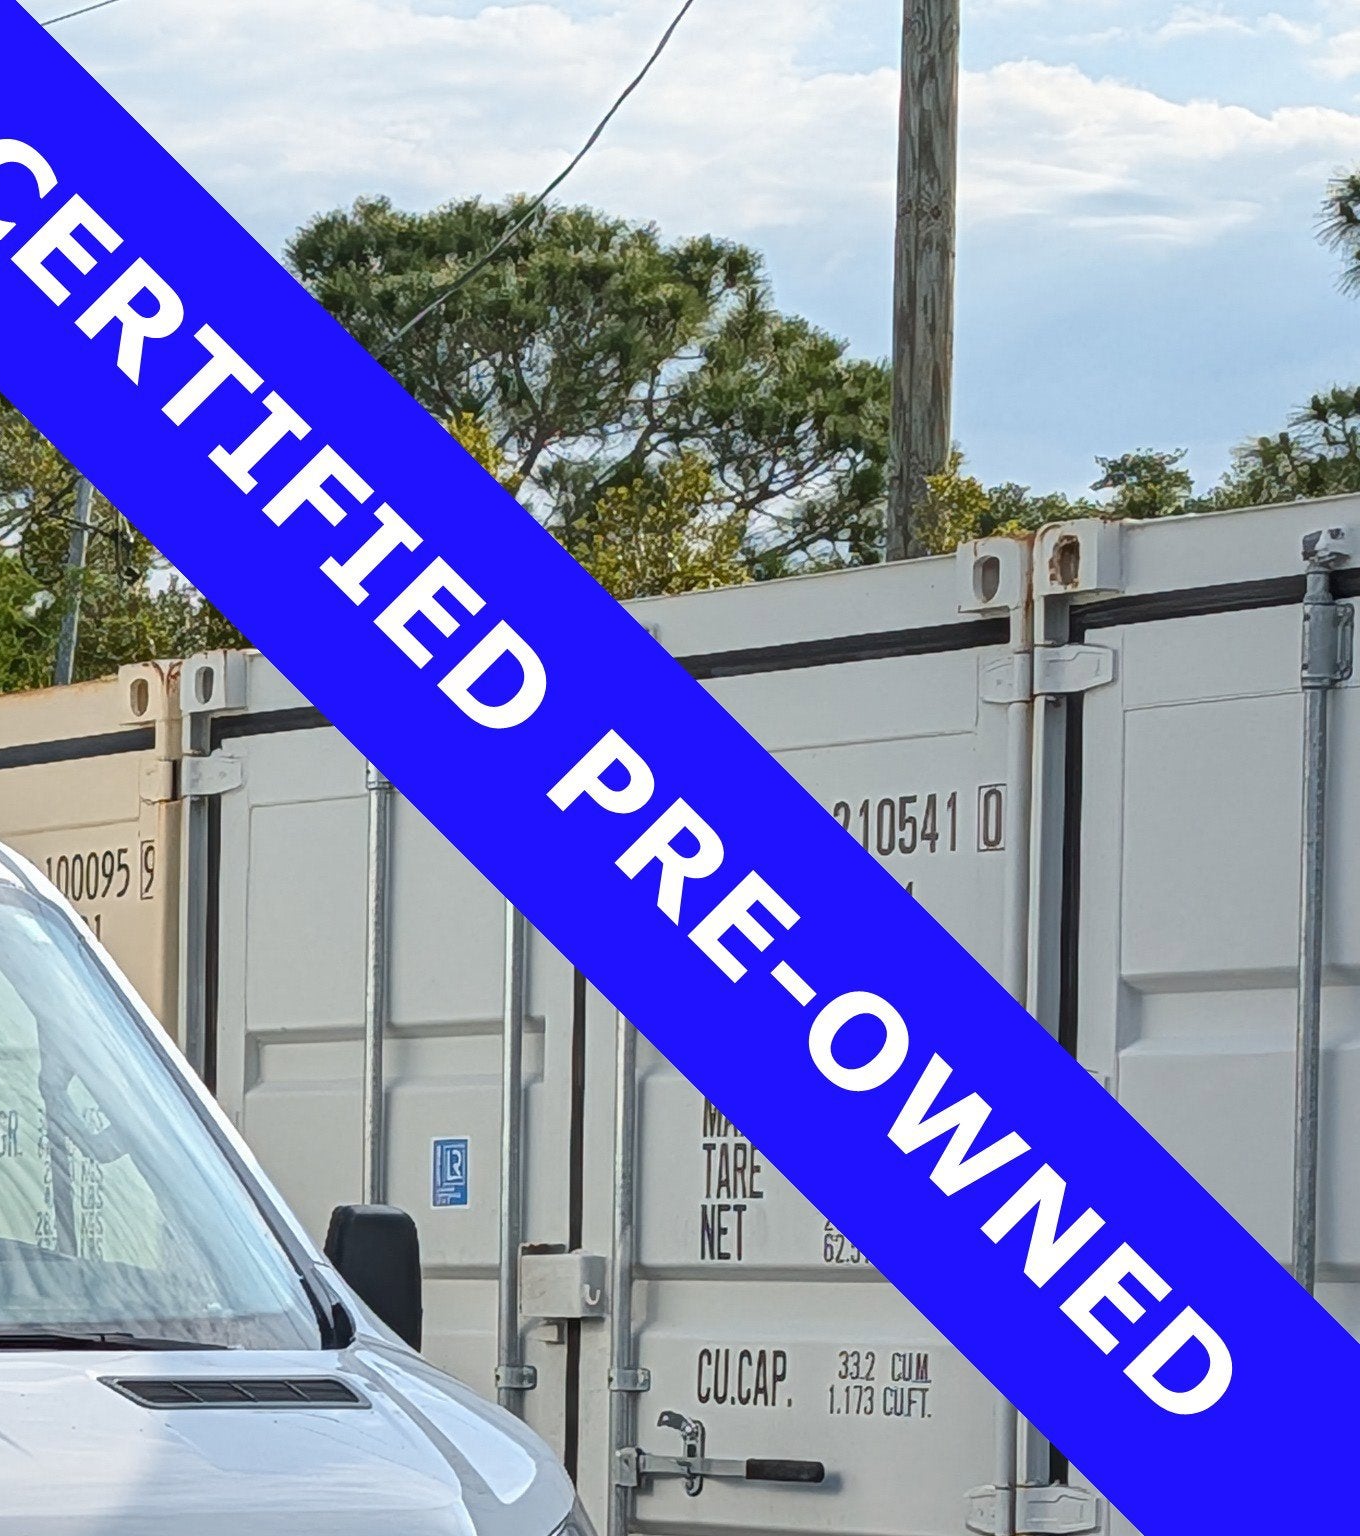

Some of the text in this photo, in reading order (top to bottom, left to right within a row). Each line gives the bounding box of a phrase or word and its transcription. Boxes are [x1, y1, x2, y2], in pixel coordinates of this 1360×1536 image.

[702, 1143, 764, 1199] TARE
[700, 1204, 747, 1261] NET
[697, 1348, 793, 1407] CU.CAP.
[829, 1384, 875, 1415] 1.173
